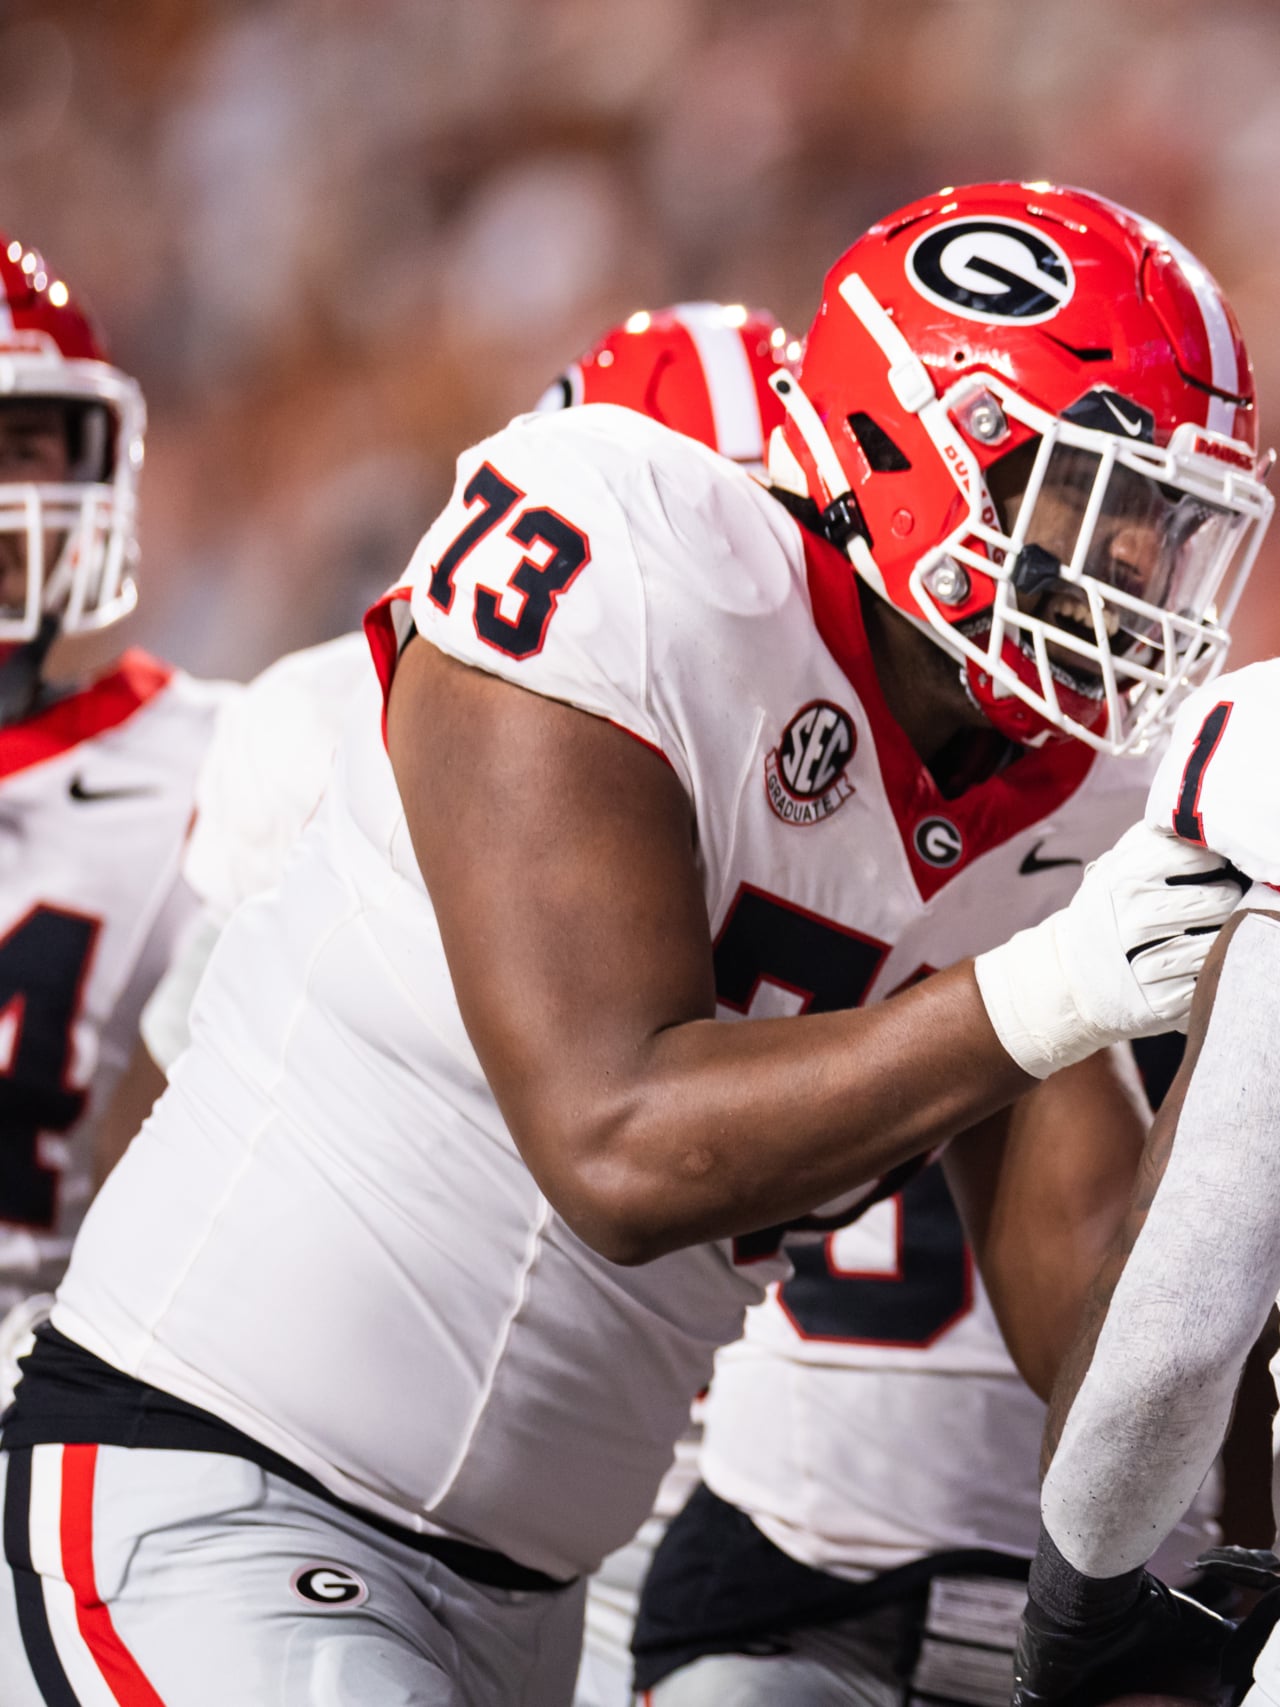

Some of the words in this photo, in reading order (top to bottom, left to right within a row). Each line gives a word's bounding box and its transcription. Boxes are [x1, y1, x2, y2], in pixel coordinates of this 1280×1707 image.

[911, 221, 1068, 318] G
[427, 460, 592, 661] 73
[781, 706, 850, 794] SEC
[1172, 700, 1235, 848] 1
[767, 773, 835, 822] GRADUATE
[916, 819, 960, 864] G
[295, 1567, 360, 1604] G
